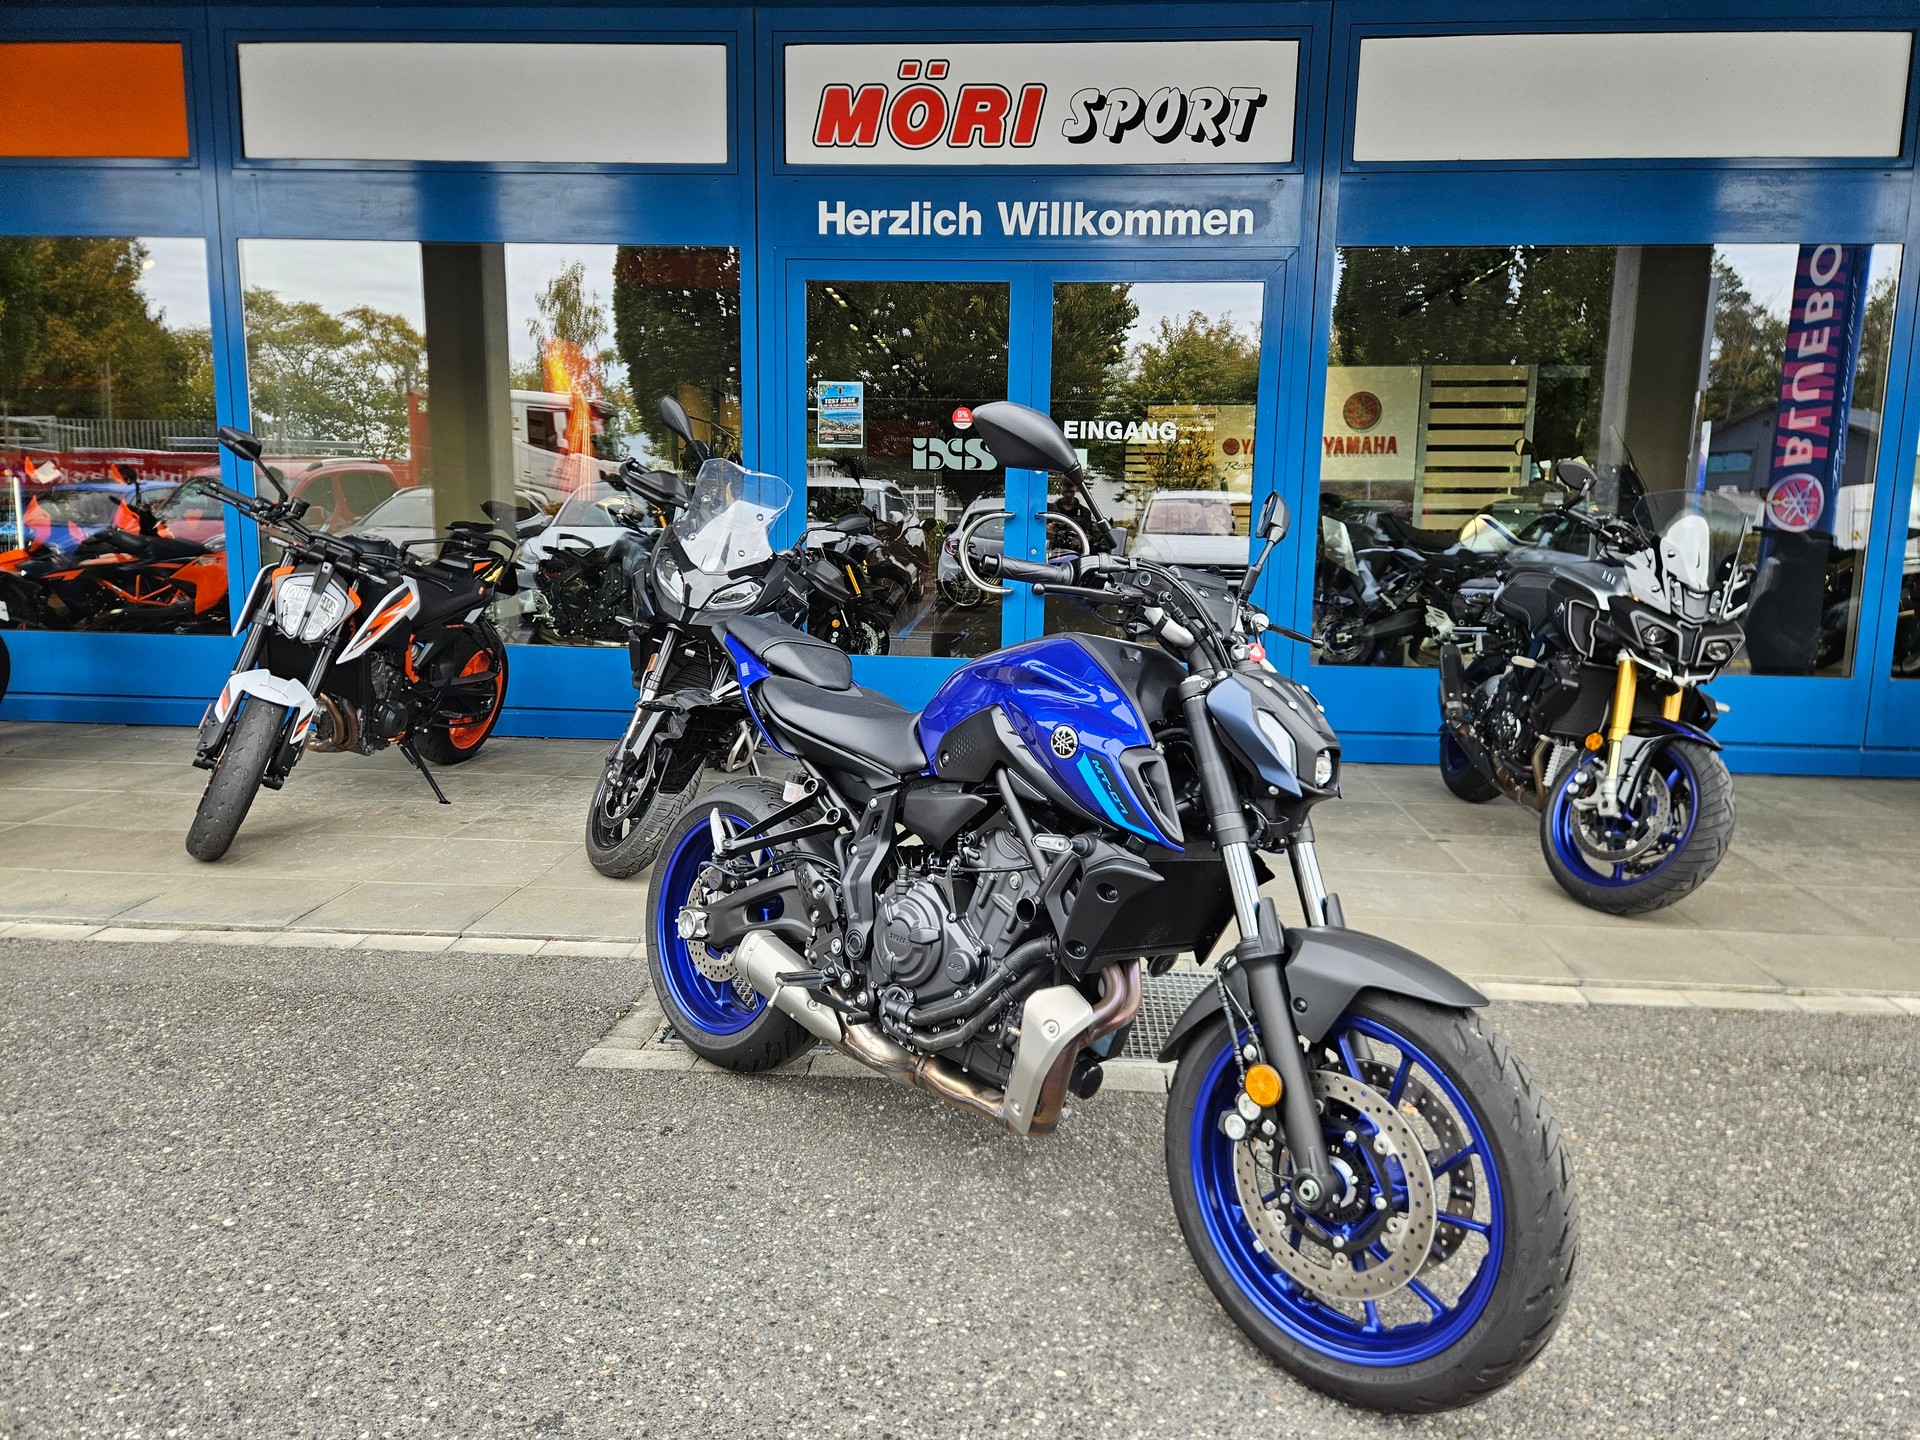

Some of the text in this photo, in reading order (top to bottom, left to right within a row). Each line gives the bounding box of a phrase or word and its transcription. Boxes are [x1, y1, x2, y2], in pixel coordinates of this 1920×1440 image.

[813, 59, 1267, 150] MÖRI SPORT
[818, 201, 1254, 236] Herzlich Willkommen
[1063, 420, 1177, 440] EINGANG
[1323, 436, 1398, 455] YAMAHA
[1091, 759, 1129, 815] MT-07
